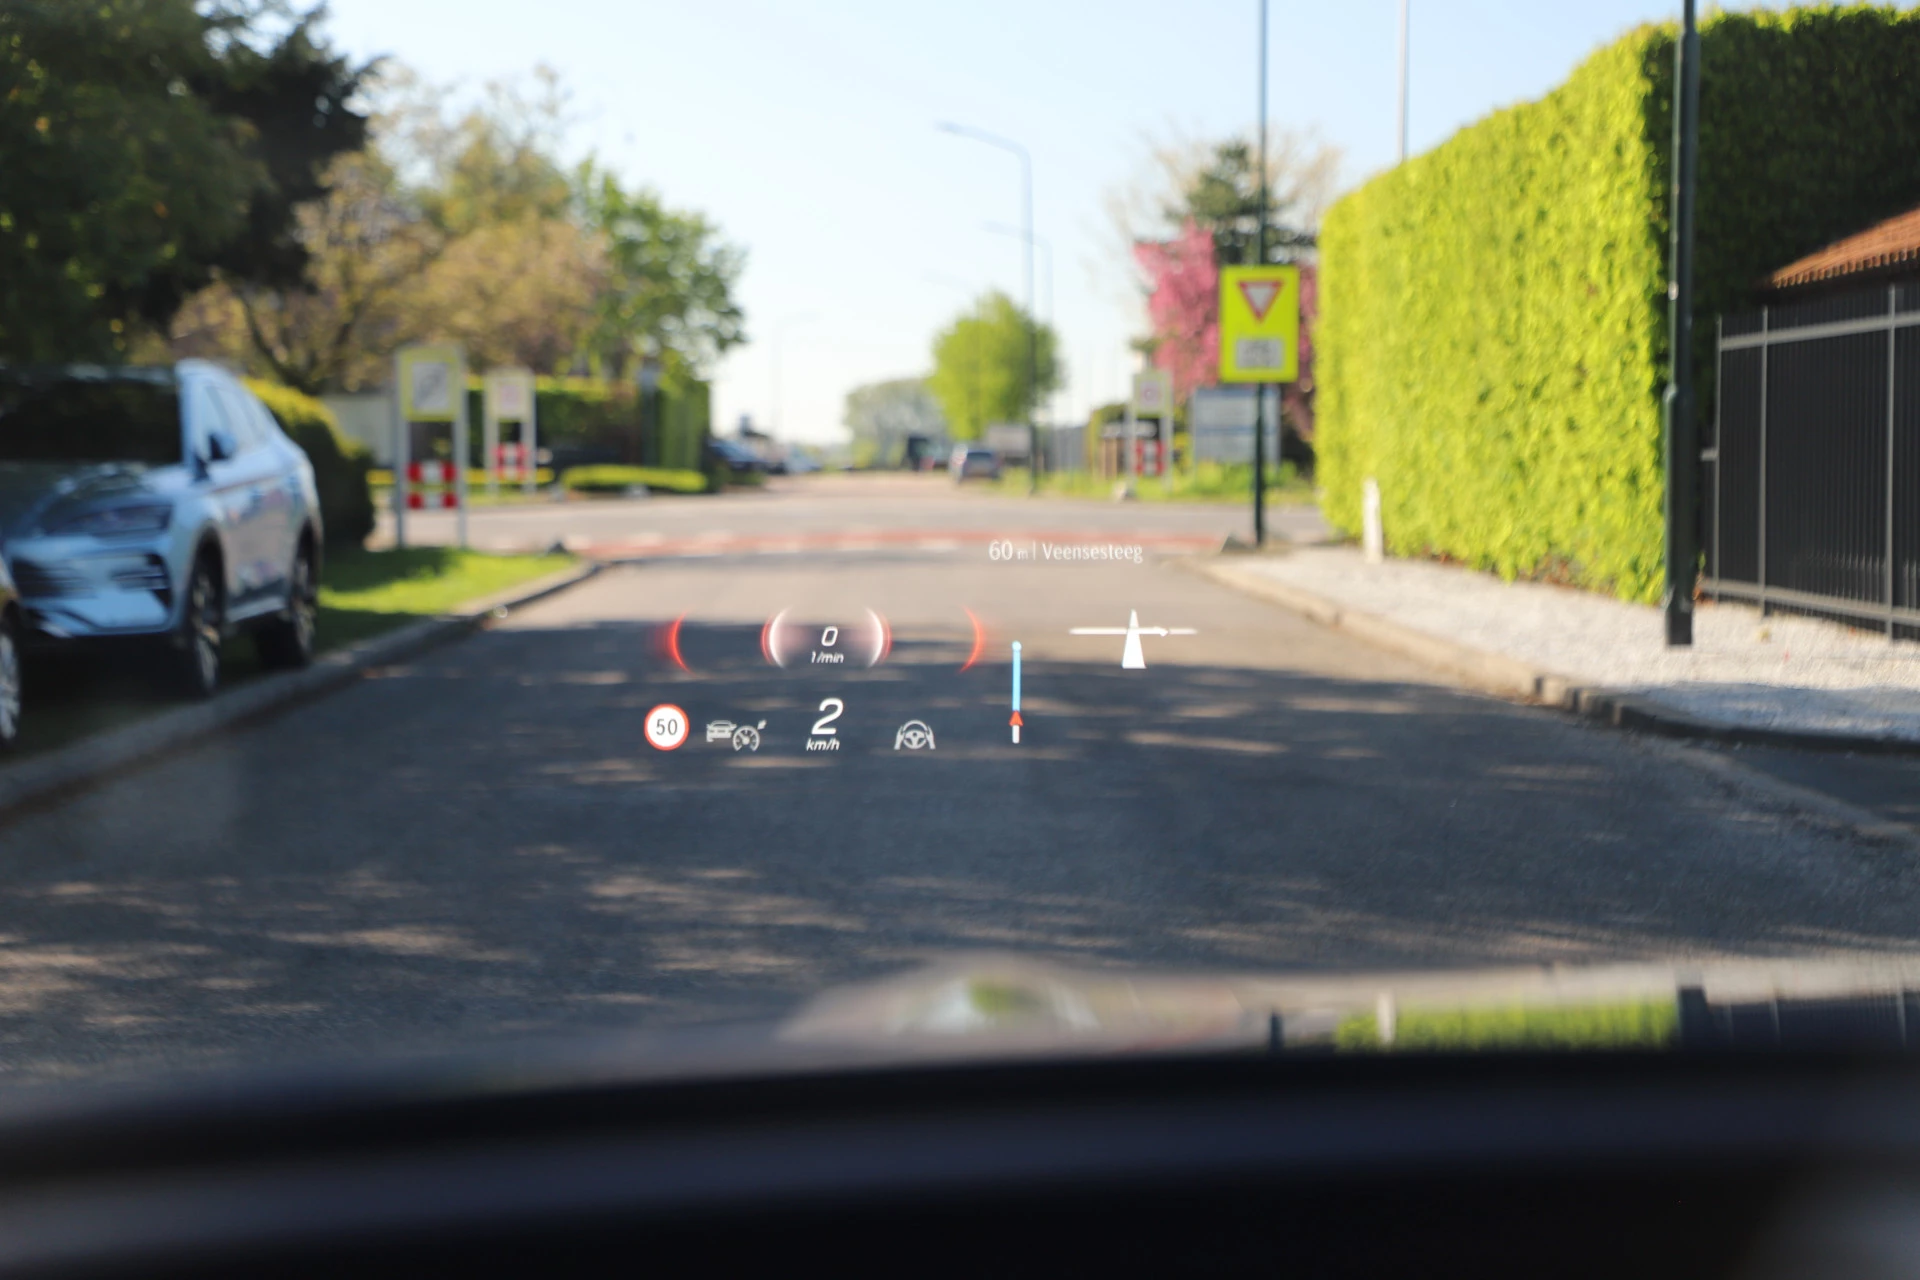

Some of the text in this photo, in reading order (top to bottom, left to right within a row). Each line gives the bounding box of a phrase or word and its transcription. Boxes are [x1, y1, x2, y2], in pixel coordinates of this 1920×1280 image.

[988, 539, 1144, 564] 60 m Veensesteeg
[821, 625, 839, 647] 0
[811, 651, 844, 664] 1/min
[811, 697, 844, 735] 2
[655, 718, 678, 736] 50
[806, 738, 840, 751] km/h
